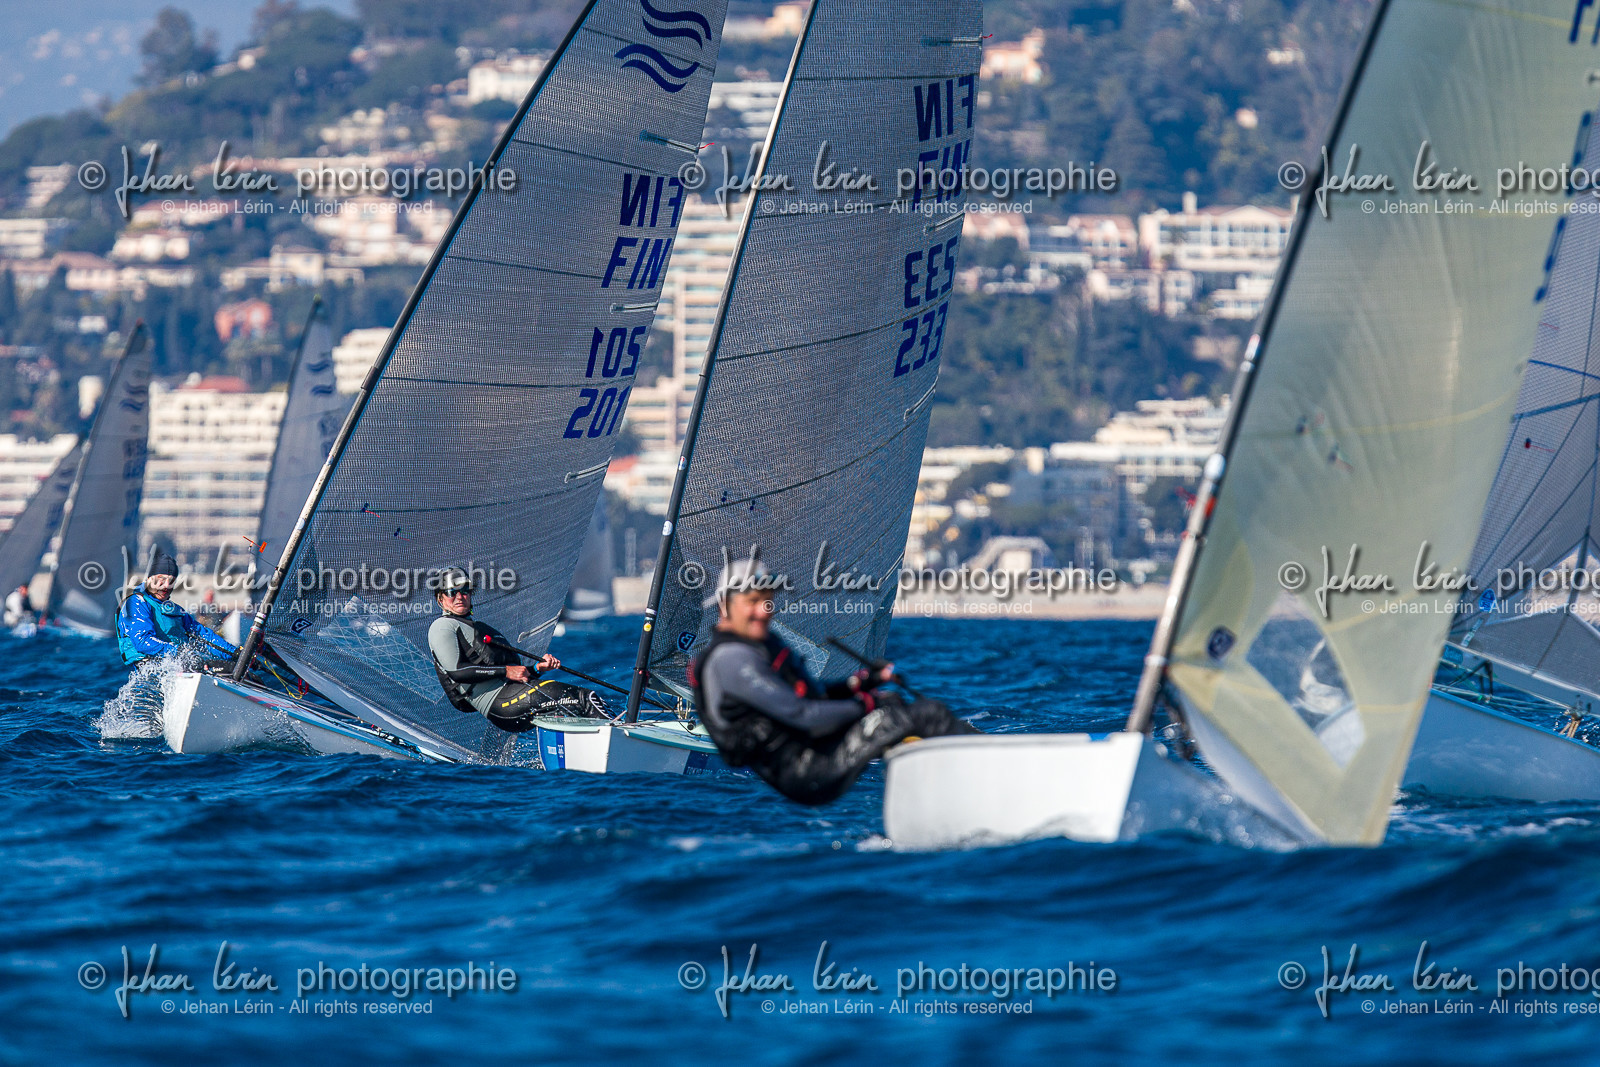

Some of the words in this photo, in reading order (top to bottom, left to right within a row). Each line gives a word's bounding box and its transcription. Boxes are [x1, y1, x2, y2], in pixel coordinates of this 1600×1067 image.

[912, 139, 971, 211] FIN
[601, 236, 672, 290] FIN
[893, 301, 949, 378] 233
[562, 385, 631, 438] 201
